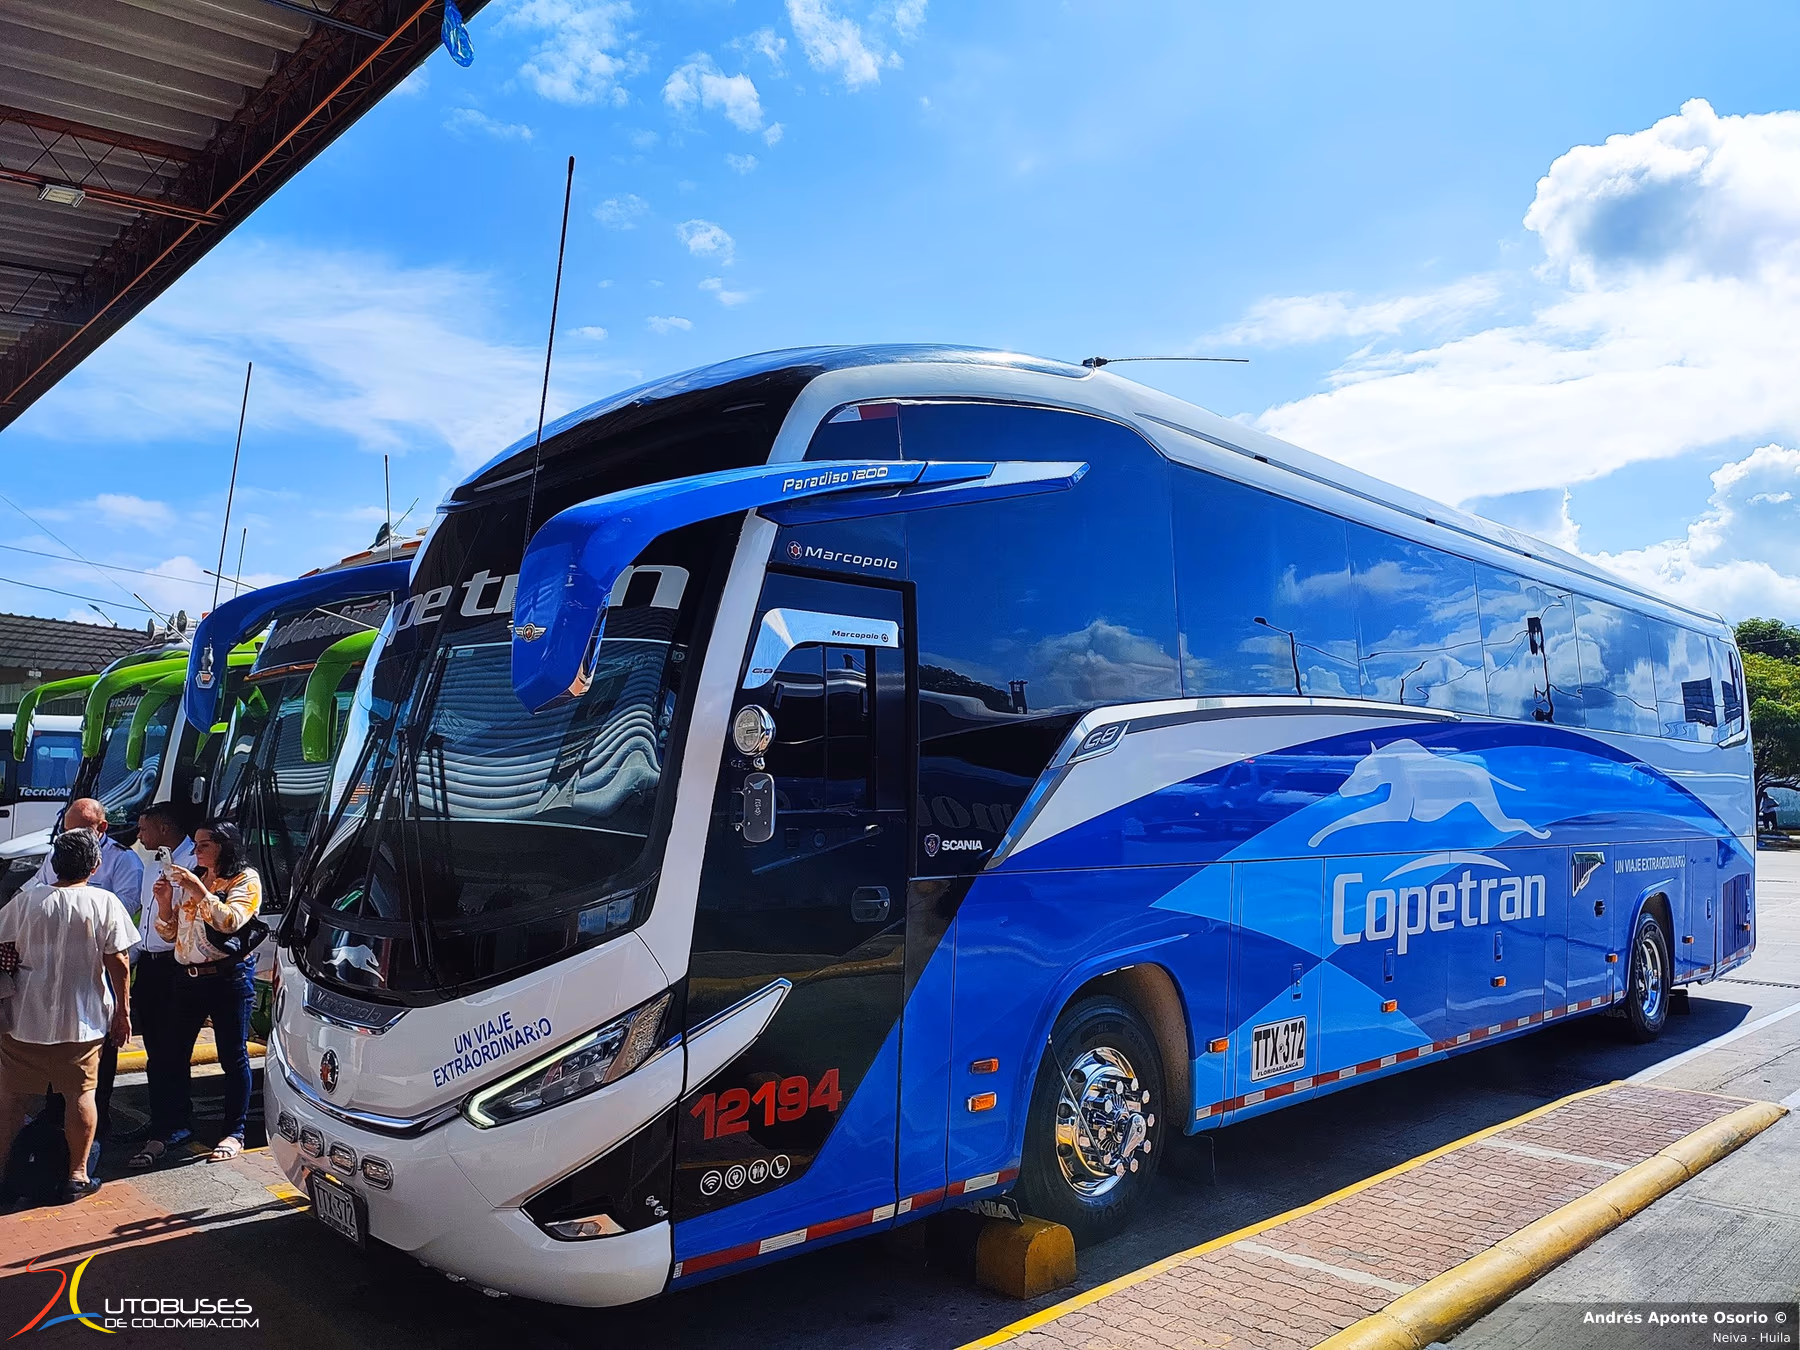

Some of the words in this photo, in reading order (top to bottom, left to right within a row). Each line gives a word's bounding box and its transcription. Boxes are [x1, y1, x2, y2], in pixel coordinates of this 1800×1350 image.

[782, 471, 849, 493] Paradiso
[851, 467, 889, 481] 1200
[804, 546, 898, 569] Marcopolo
[831, 630, 879, 640] Marcopolo
[1083, 726, 1119, 749] G8
[941, 839, 983, 851] SCANIA
[1615, 860, 1624, 874] UN
[1625, 858, 1641, 872] VIAJE
[1332, 870, 1546, 955] Copetran
[453, 1031, 473, 1054] UN
[473, 1011, 514, 1044] VIAJE
[432, 1018, 552, 1088] EXTRAORDINARIO
[690, 1068, 842, 1140] 12194
